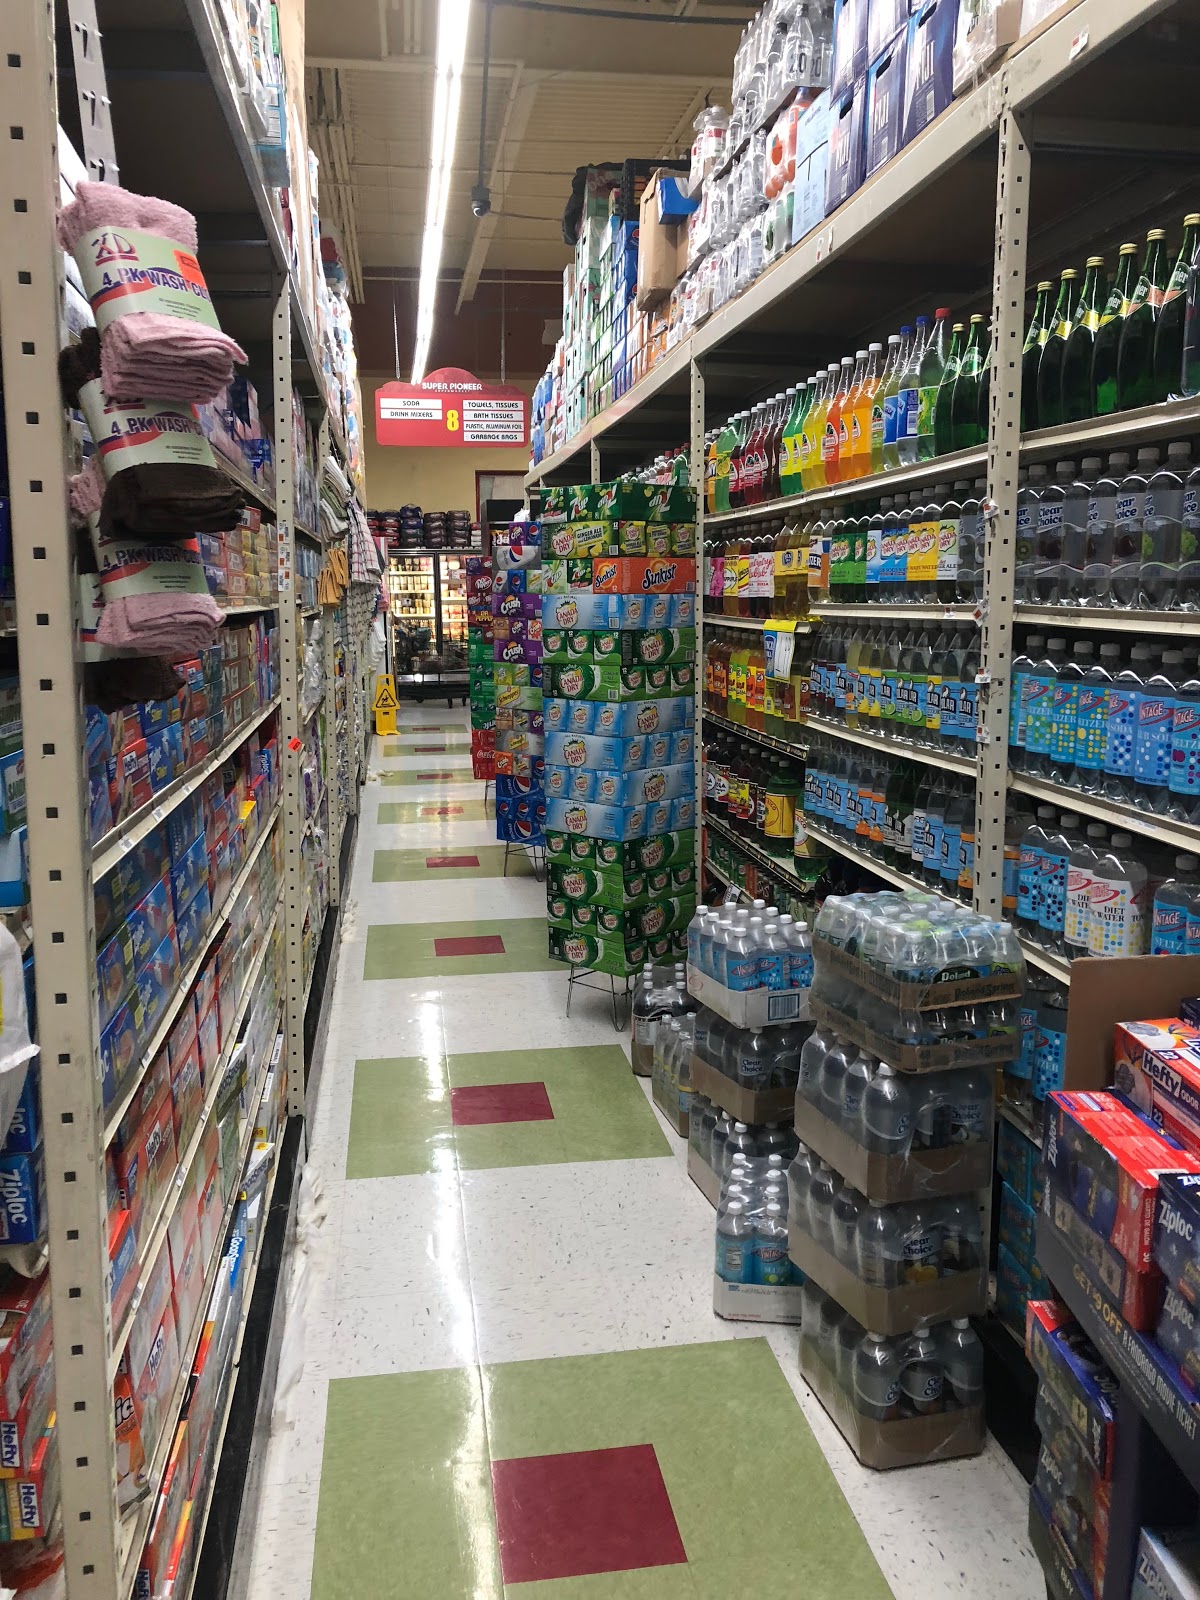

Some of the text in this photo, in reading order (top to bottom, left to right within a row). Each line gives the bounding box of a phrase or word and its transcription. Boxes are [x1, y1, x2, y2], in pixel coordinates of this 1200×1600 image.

[103, 272, 113, 287] 4
[117, 267, 145, 285] PK
[145, 269, 190, 293] WASH
[422, 382, 483, 391] SUPER PIONEER
[111, 420, 122, 436] 4
[126, 416, 151, 434] PK
[154, 417, 191, 434] WASH
[446, 409, 459, 431] 8
[552, 534, 574, 549] CANADA
[558, 543, 570, 553] DRY
[142, 546, 181, 563] WASH
[595, 563, 618, 589] Sunkist
[642, 562, 678, 590] Sunkist
[501, 597, 521, 615] Crush
[556, 608, 579, 620] CANADA
[563, 616, 575, 626] DRY
[502, 644, 524, 661] Crush
[641, 639, 665, 654] CANADA
[648, 648, 661, 659] DRY
[560, 675, 583, 689] CANADA
[566, 683, 579, 693] DRY
[1140, 702, 1163, 720] NTAGE
[637, 713, 659, 728] CANADA
[643, 720, 655, 730] DRY
[564, 747, 587, 760] CANADA
[570, 756, 583, 764] DRY
[644, 779, 666, 796] CANADA
[650, 787, 662, 799] DRY
[565, 815, 587, 826] CANADA
[572, 823, 583, 831] DRY
[642, 845, 665, 864] CANADA
[648, 854, 661, 866] DRY
[562, 878, 587, 890] CANADA
[570, 885, 582, 895] DRY
[1078, 894, 1091, 902] DIE
[1097, 912, 1125, 922] WATER
[1103, 905, 1126, 915] DIET
[642, 911, 665, 930] CANADA
[648, 920, 661, 932] DRY
[564, 943, 589, 956] CANADA
[571, 951, 584, 960] DRY
[941, 970, 971, 982] Poland
[741, 1065, 763, 1073] Choice
[742, 1059, 761, 1067] Clear
[1143, 1055, 1200, 1111] Hefty ODOR
[1152, 1108, 1164, 1127] 22
[1047, 1115, 1058, 1169] Ziploc
[0, 1168, 28, 1225] Ziploc
[1158, 1199, 1193, 1242] Ziploc
[1163, 1285, 1195, 1330] Ziploc
[1072, 1263, 1092, 1295] GET
[1102, 1303, 1123, 1335] OFF
[1122, 1329, 1128, 1347] A
[1156, 1375, 1176, 1413] MOVIE
[1175, 1400, 1197, 1440] TICKET
[2, 1422, 18, 1466] Hefty
[22, 1484, 37, 1526] Hefty
